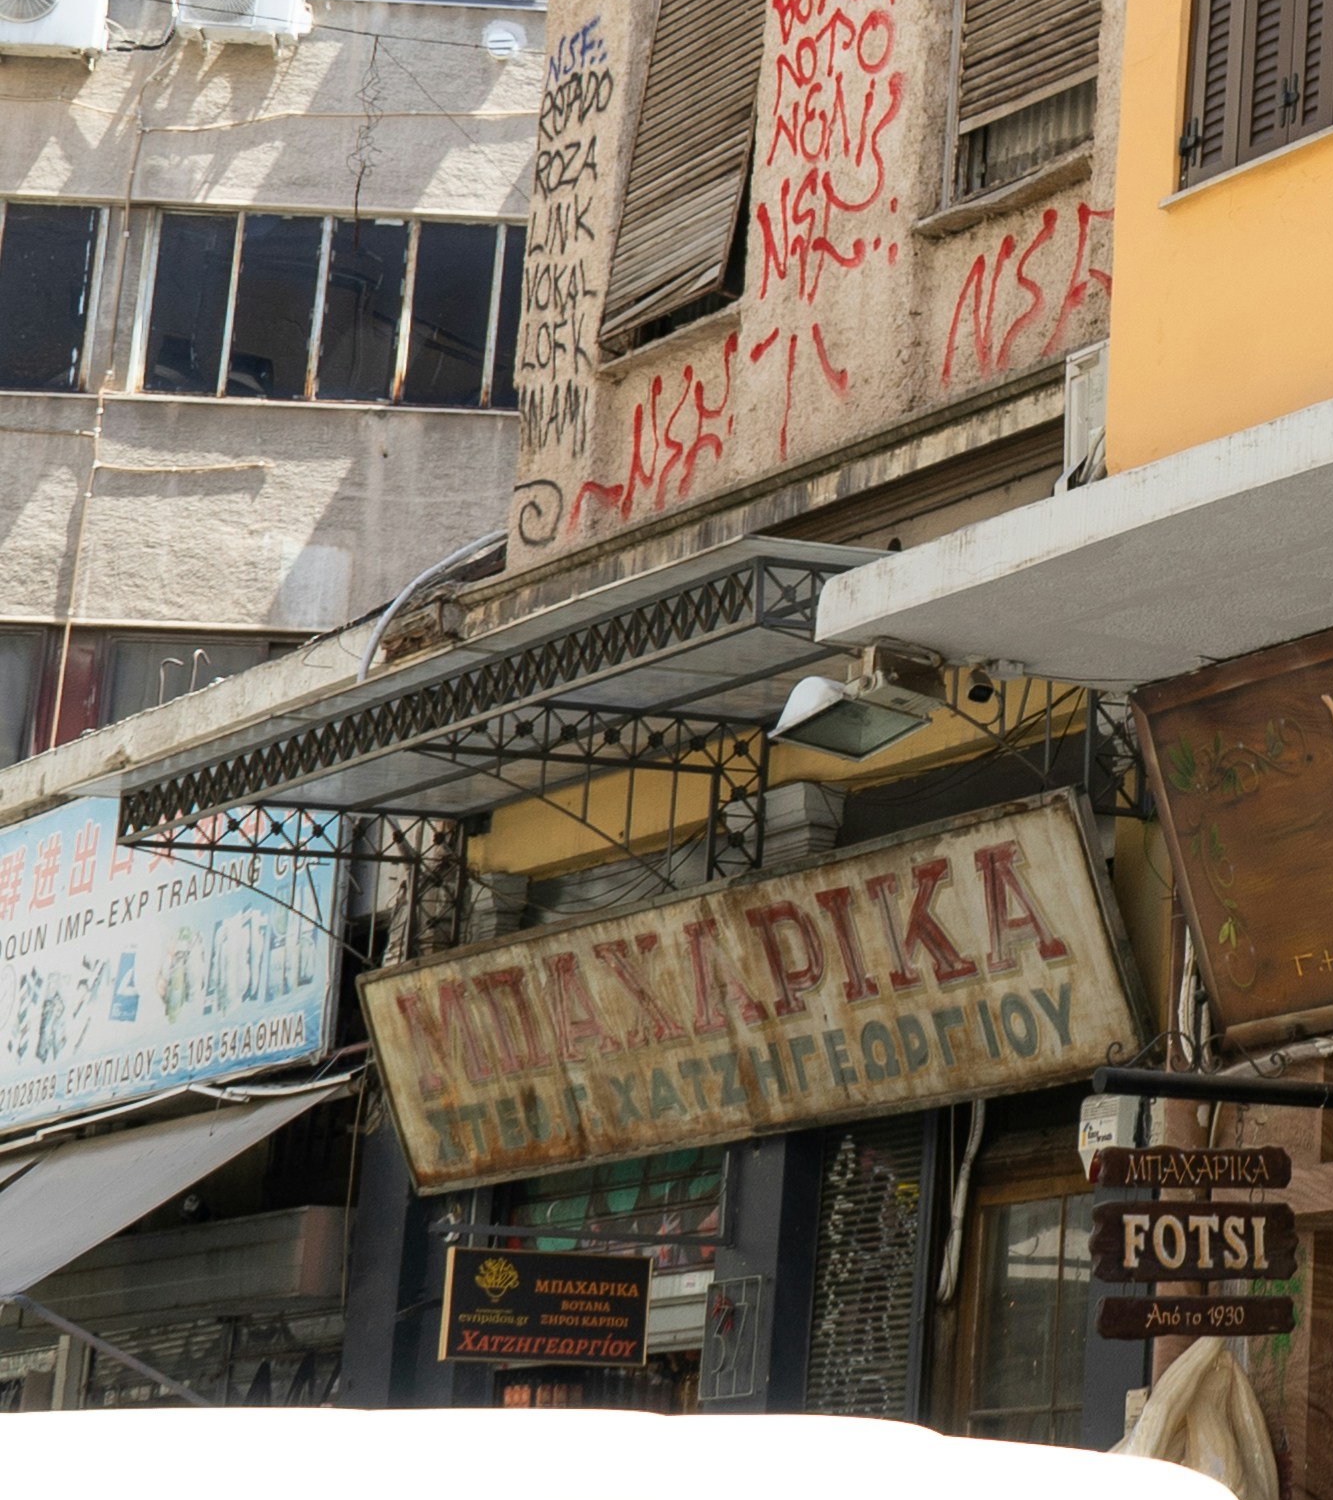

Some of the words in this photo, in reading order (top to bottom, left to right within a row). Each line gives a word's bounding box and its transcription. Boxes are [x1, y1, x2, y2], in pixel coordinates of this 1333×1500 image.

[535, 136, 598, 199] ROZA
[528, 193, 595, 257] LINK
[526, 259, 598, 318] VOKAL
[56, 894, 149, 945] IMP-EXP
[157, 853, 261, 914] TRADING
[398, 840, 1072, 1095] ΜΠΑΧΑΡΙΚΑ
[161, 1042, 180, 1073] 35
[188, 1034, 214, 1065] 105
[220, 1028, 237, 1060] 54
[242, 1014, 305, 1056] ΑΘΗΝΑ
[608, 984, 1074, 1130] ΧΑΤΖΗΓΕΩΡΓΙΟΥ
[1125, 1154, 1270, 1185] ΜΠΑΧΑΡΙΚΑ
[1123, 1213, 1269, 1269] FOTSI
[534, 1279, 639, 1298] ΜΠΑΧΑΡΙΚΑ
[1146, 1303, 1180, 1328] Από
[1186, 1309, 1201, 1324] το
[1207, 1305, 1245, 1327] 1930
[458, 1313, 529, 1325] evripidou.gr
